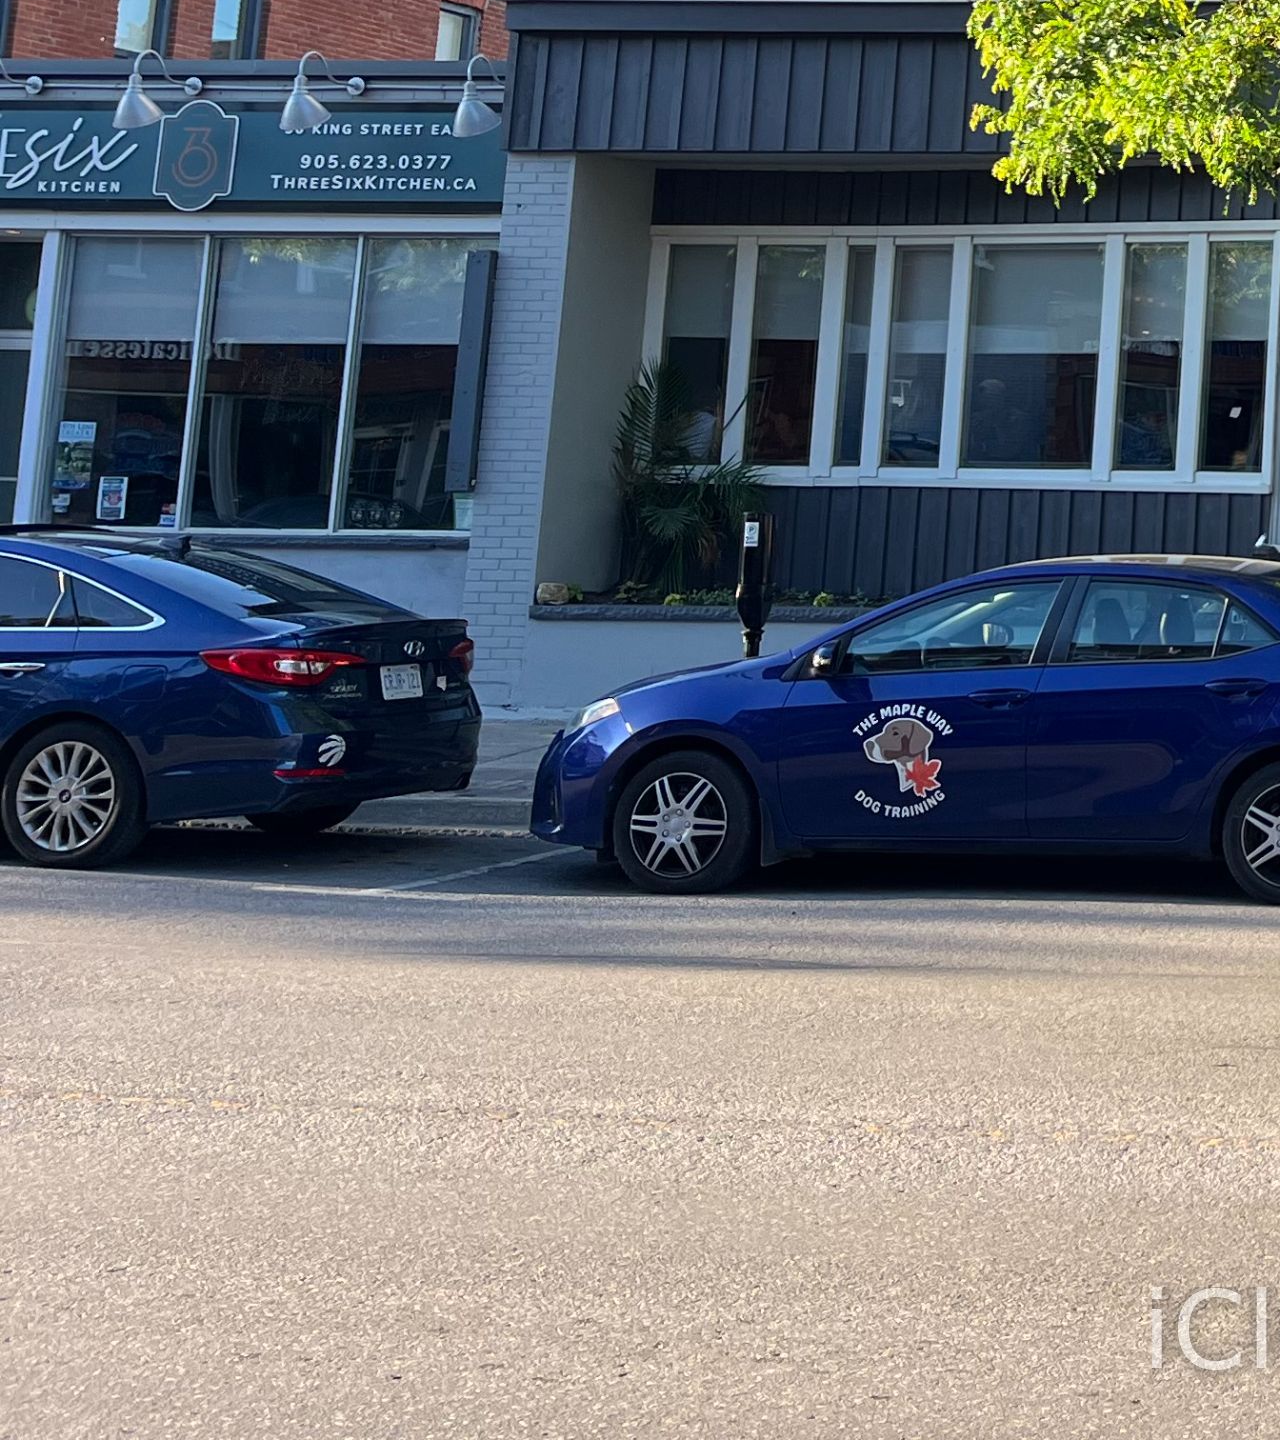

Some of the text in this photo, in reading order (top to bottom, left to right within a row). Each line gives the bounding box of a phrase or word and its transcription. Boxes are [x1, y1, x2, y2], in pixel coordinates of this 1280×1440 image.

[312, 124, 352, 136] KING
[360, 124, 424, 136] STREET
[300, 154, 451, 170] 905.623.0377
[37, 181, 121, 193] KITCHEN
[852, 703, 954, 736] THE MAPLE WAY
[854, 789, 946, 818] DOG TRAINING
